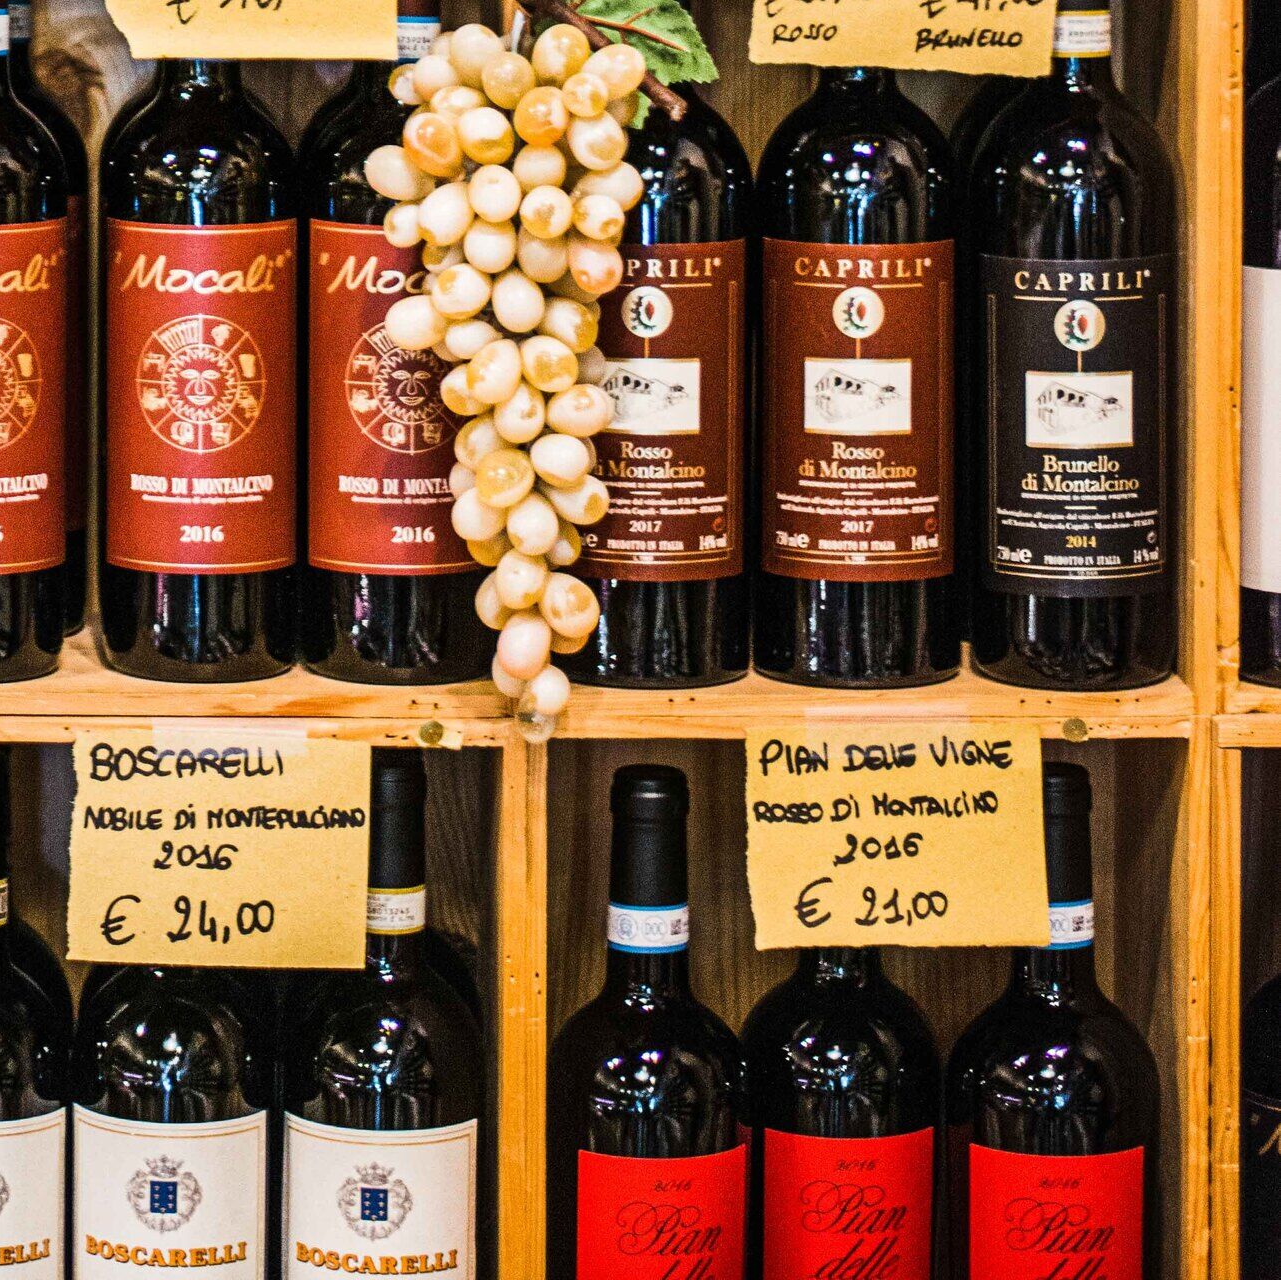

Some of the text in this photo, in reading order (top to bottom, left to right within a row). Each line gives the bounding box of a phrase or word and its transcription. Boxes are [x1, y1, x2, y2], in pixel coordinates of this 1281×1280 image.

[772, 23, 838, 44] ROSSO
[1014, 270, 1144, 291] CAPRILI
[1042, 455, 1120, 473] Brunello
[1021, 472, 1140, 494] di Montalcino
[1065, 535, 1097, 549] 2014
[89, 742, 285, 782] BOSCARELLI
[758, 735, 1014, 777] PIAN DELLE VIGNE
[152, 840, 239, 870] 2016
[832, 831, 925, 867] 2016
[794, 876, 949, 929] € 21,00
[100, 894, 142, 946] €
[799, 1180, 908, 1235] Pian
[85, 1234, 249, 1268] BOSCARELLI
